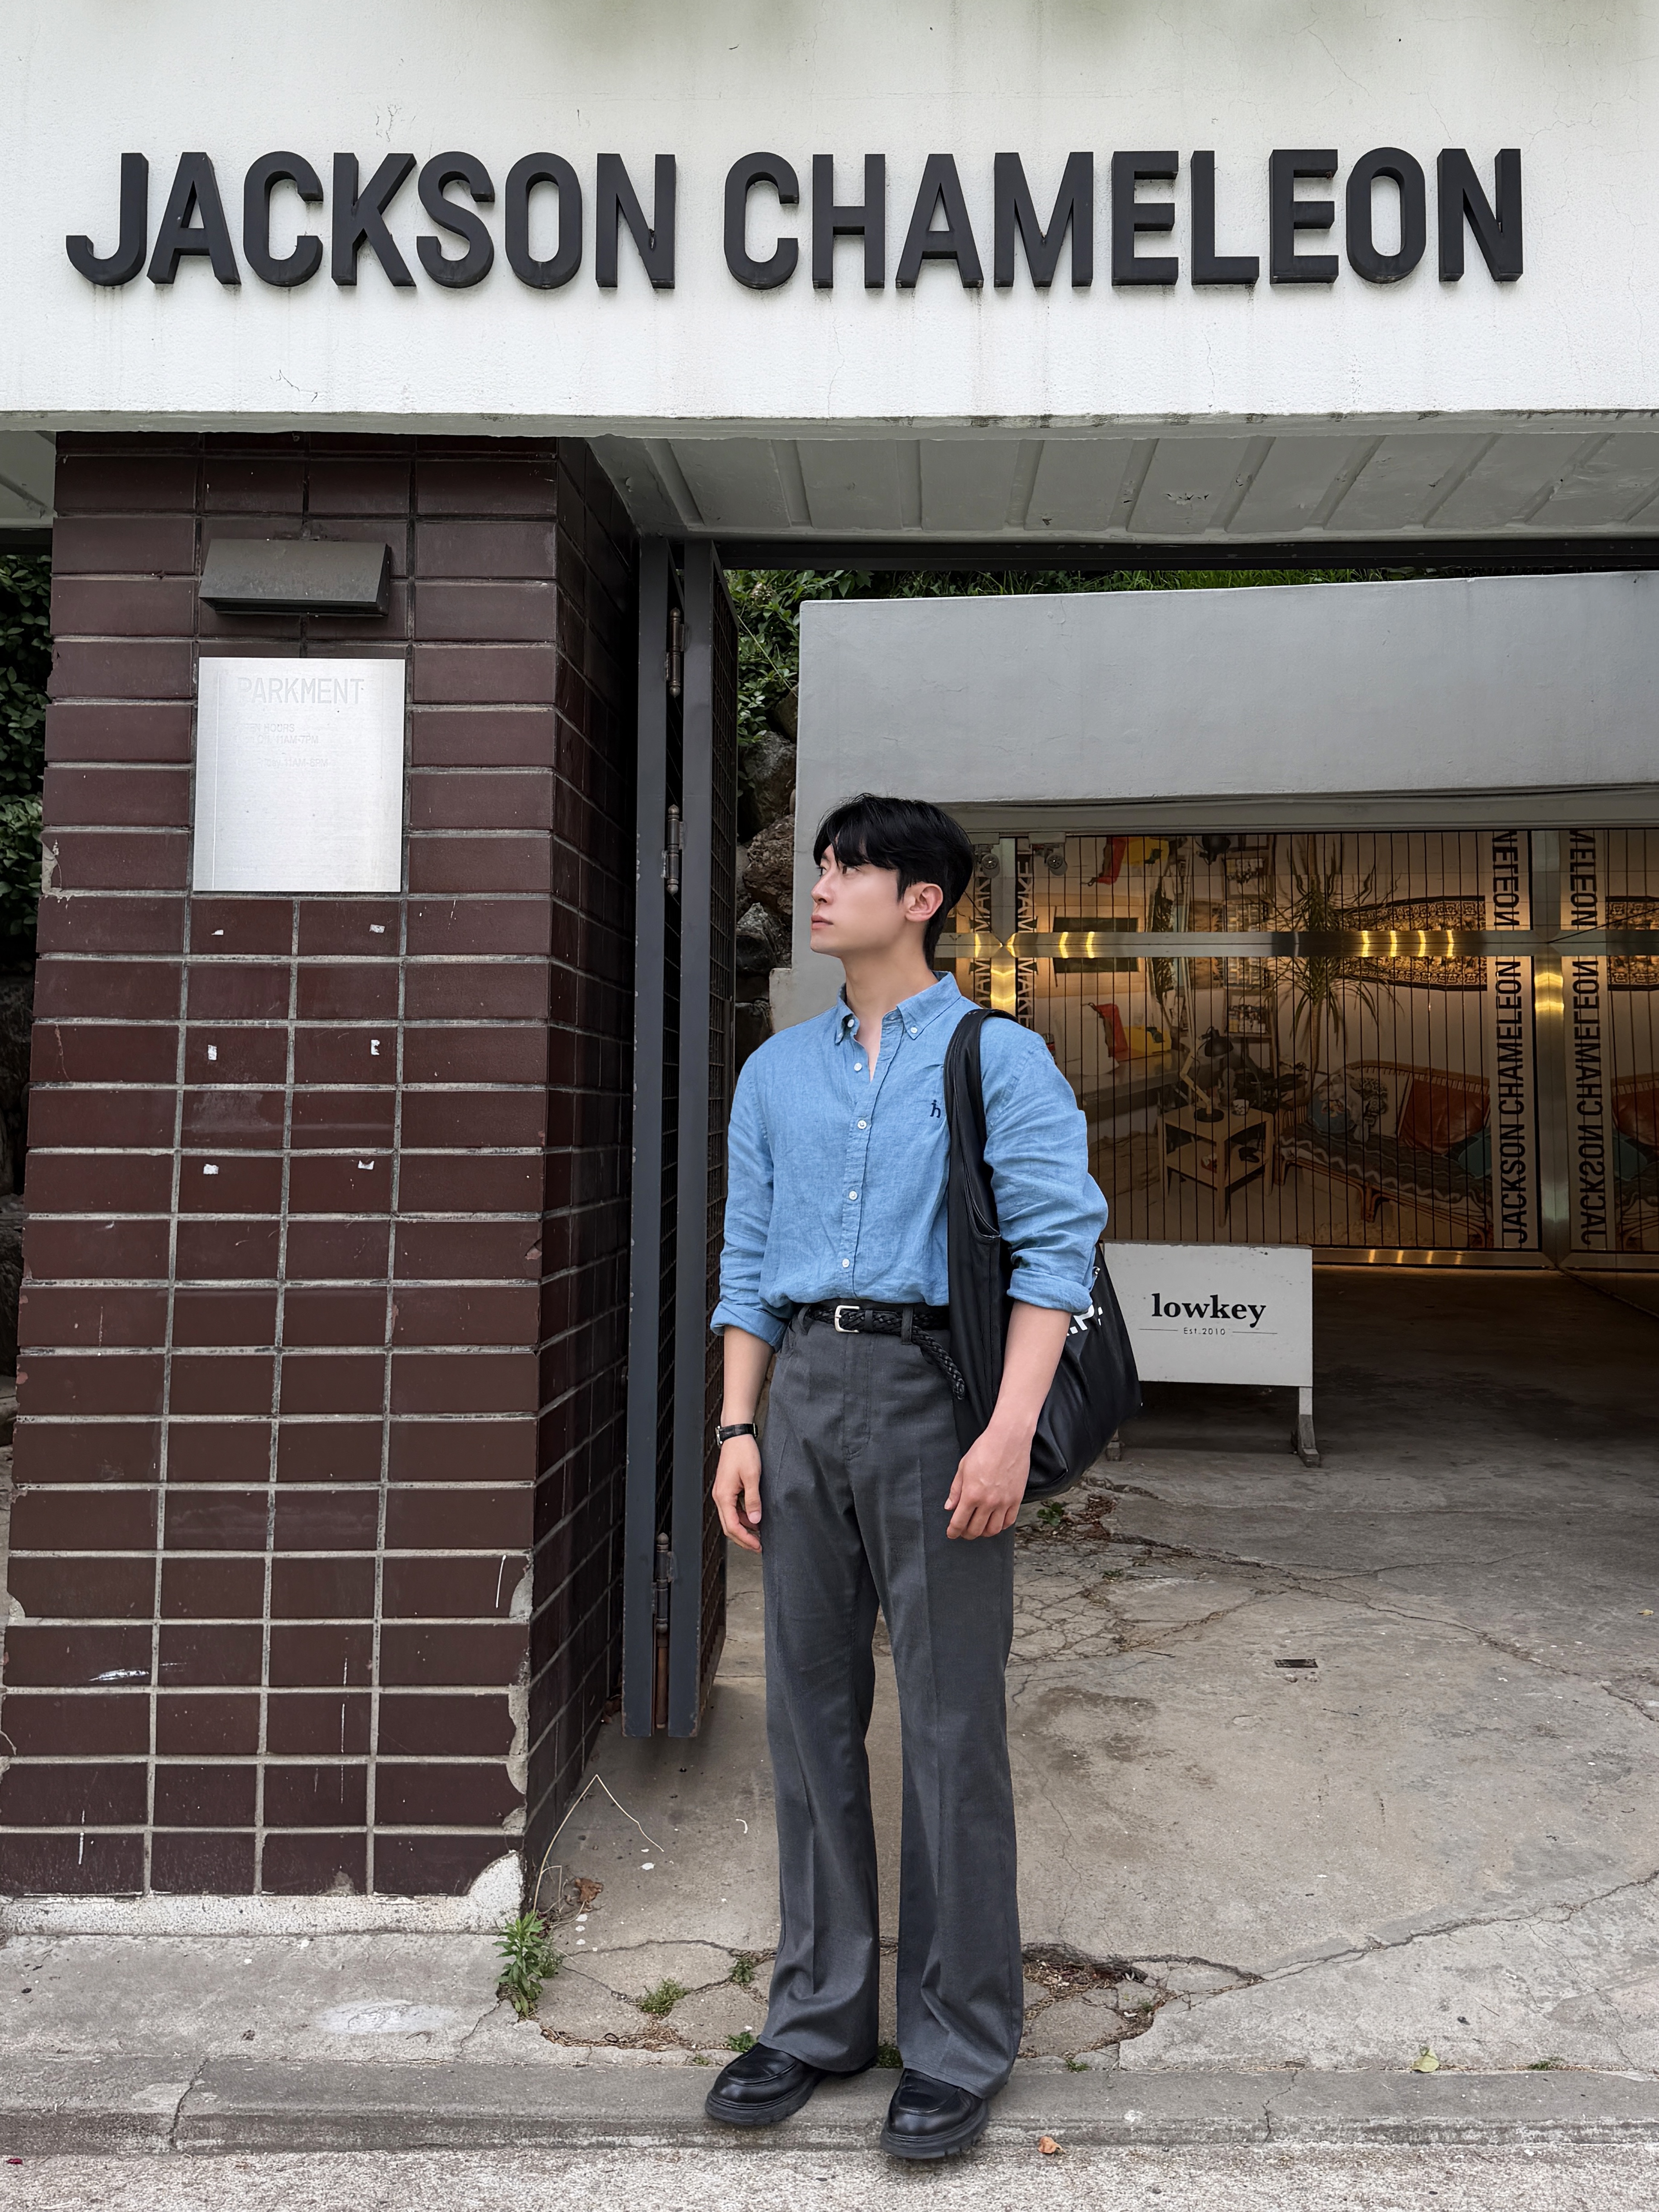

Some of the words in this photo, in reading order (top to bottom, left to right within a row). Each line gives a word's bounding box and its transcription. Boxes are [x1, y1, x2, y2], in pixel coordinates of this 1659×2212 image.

[66, 151, 676, 290] JACKSON
[724, 147, 1523, 291] CHAMELEON
[237, 677, 364, 704] PARKMENT
[264, 723, 295, 733] HOURS
[1495, 961, 1525, 1115] CHAMELEON
[1499, 1124, 1528, 1244] JACKSON
[1151, 1293, 1267, 1328] lowkey
